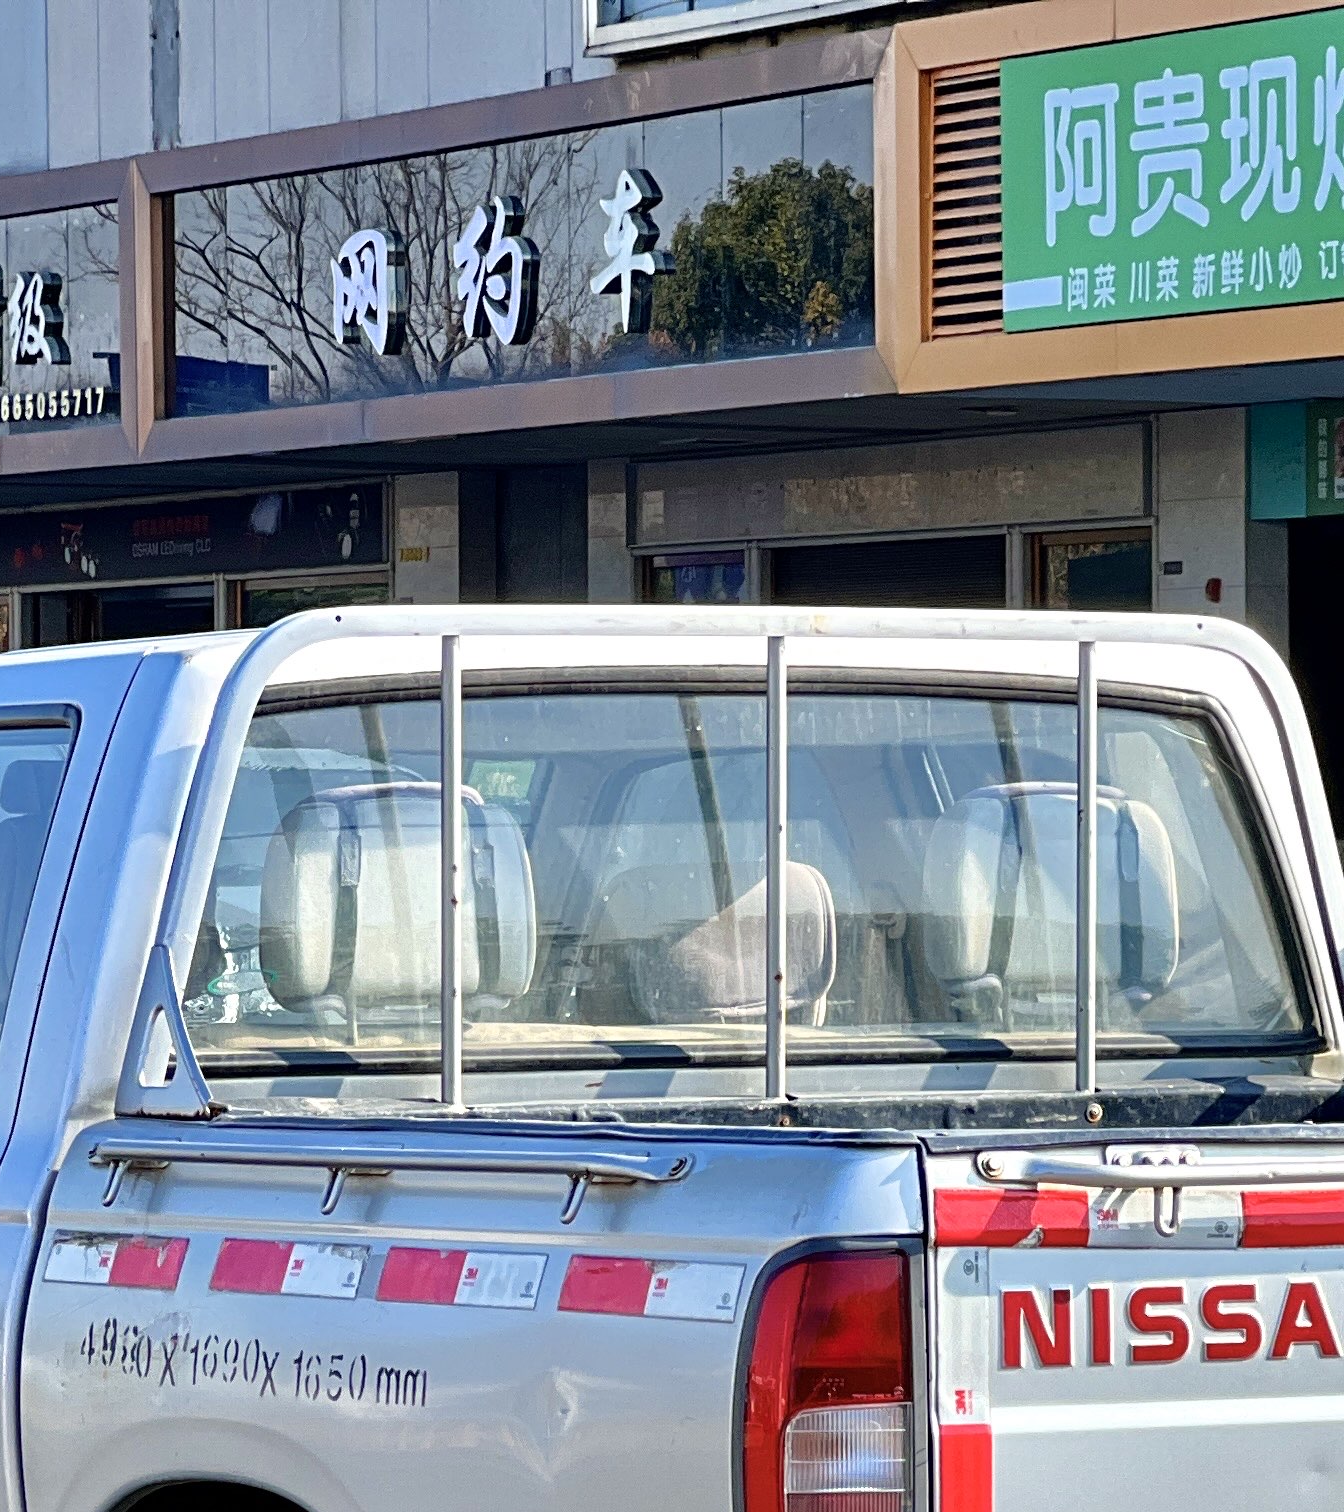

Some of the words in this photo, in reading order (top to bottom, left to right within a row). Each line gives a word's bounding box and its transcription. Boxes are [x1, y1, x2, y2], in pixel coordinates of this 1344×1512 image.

[331, 168, 656, 356] 网约车
[1067, 263, 1117, 312] 闽菜
[1129, 255, 1179, 303] 川菜
[1192, 242, 1303, 298] 新鲜小炒
